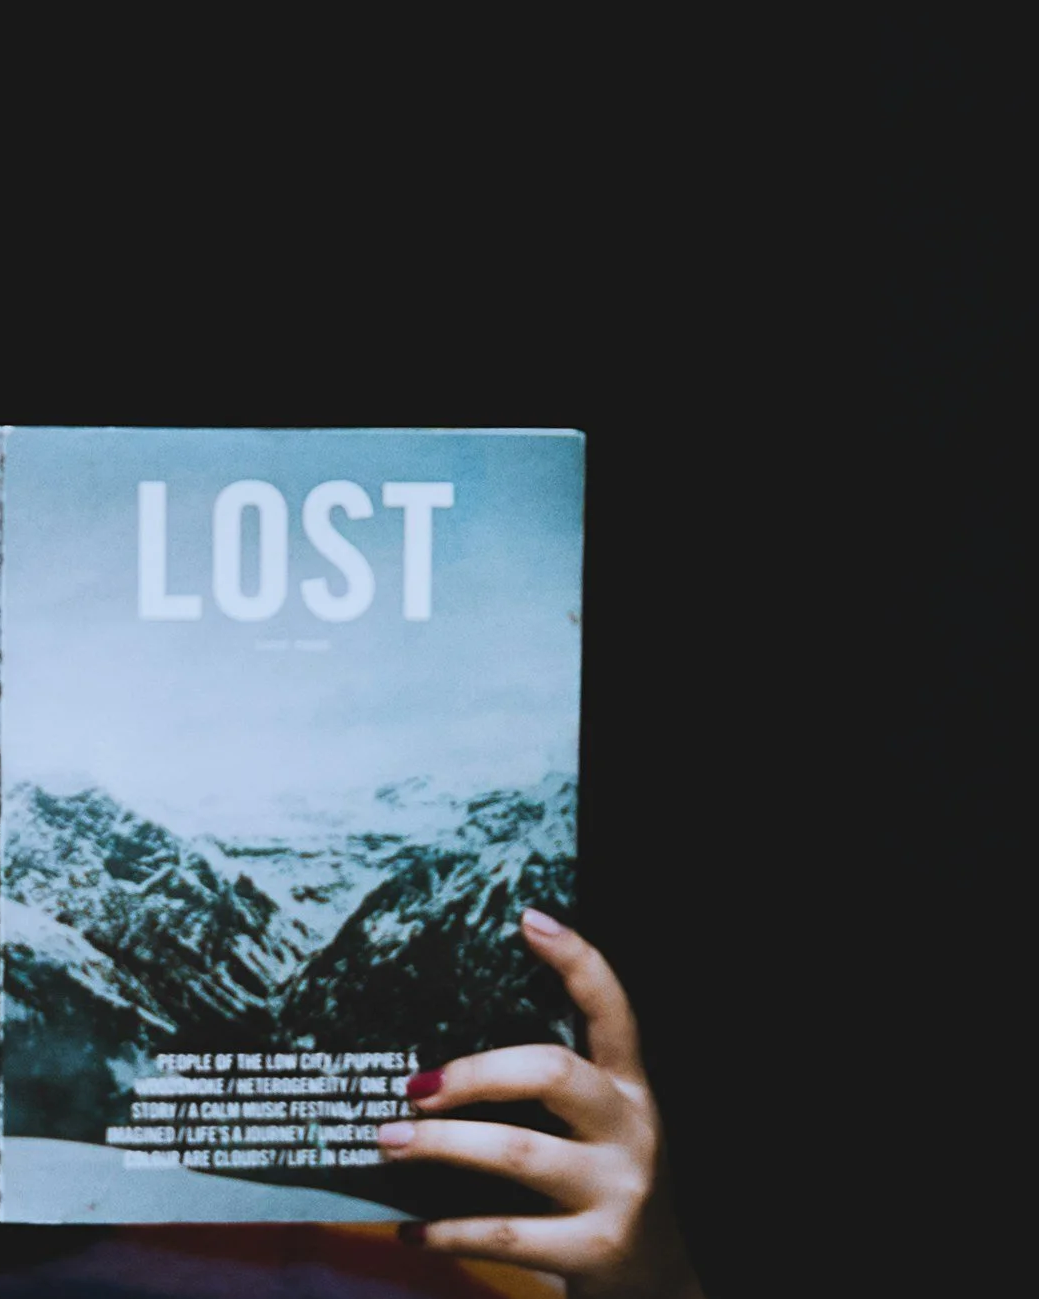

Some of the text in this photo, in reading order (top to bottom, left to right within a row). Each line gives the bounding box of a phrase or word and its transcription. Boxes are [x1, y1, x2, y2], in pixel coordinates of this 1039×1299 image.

[137, 479, 455, 622] LOST
[156, 1053, 212, 1070] PEOPLE
[214, 1053, 233, 1070] OF
[237, 1053, 263, 1070] THE
[265, 1053, 297, 1070] LOW
[300, 1053, 332, 1070] CITY
[343, 1053, 405, 1070] PUPPIES
[236, 1077, 349, 1095] HETEROGENEITY
[360, 1077, 388, 1095] ONE
[131, 1101, 177, 1119] STORY
[187, 1101, 199, 1119] A
[200, 1101, 240, 1119] CALM
[242, 1101, 287, 1119] MUSIC
[290, 1101, 352, 1119] FESTIVAL
[365, 1101, 397, 1119] JUST
[105, 1125, 176, 1143] IMAGINED
[186, 1125, 230, 1143] LIFE'S
[232, 1125, 242, 1143] A
[244, 1125, 305, 1143] JOURNEY
[183, 1149, 211, 1167] ARE
[213, 1149, 276, 1167] CLOUDS?
[287, 1149, 318, 1167] LIFE
[320, 1149, 336, 1167] IN
